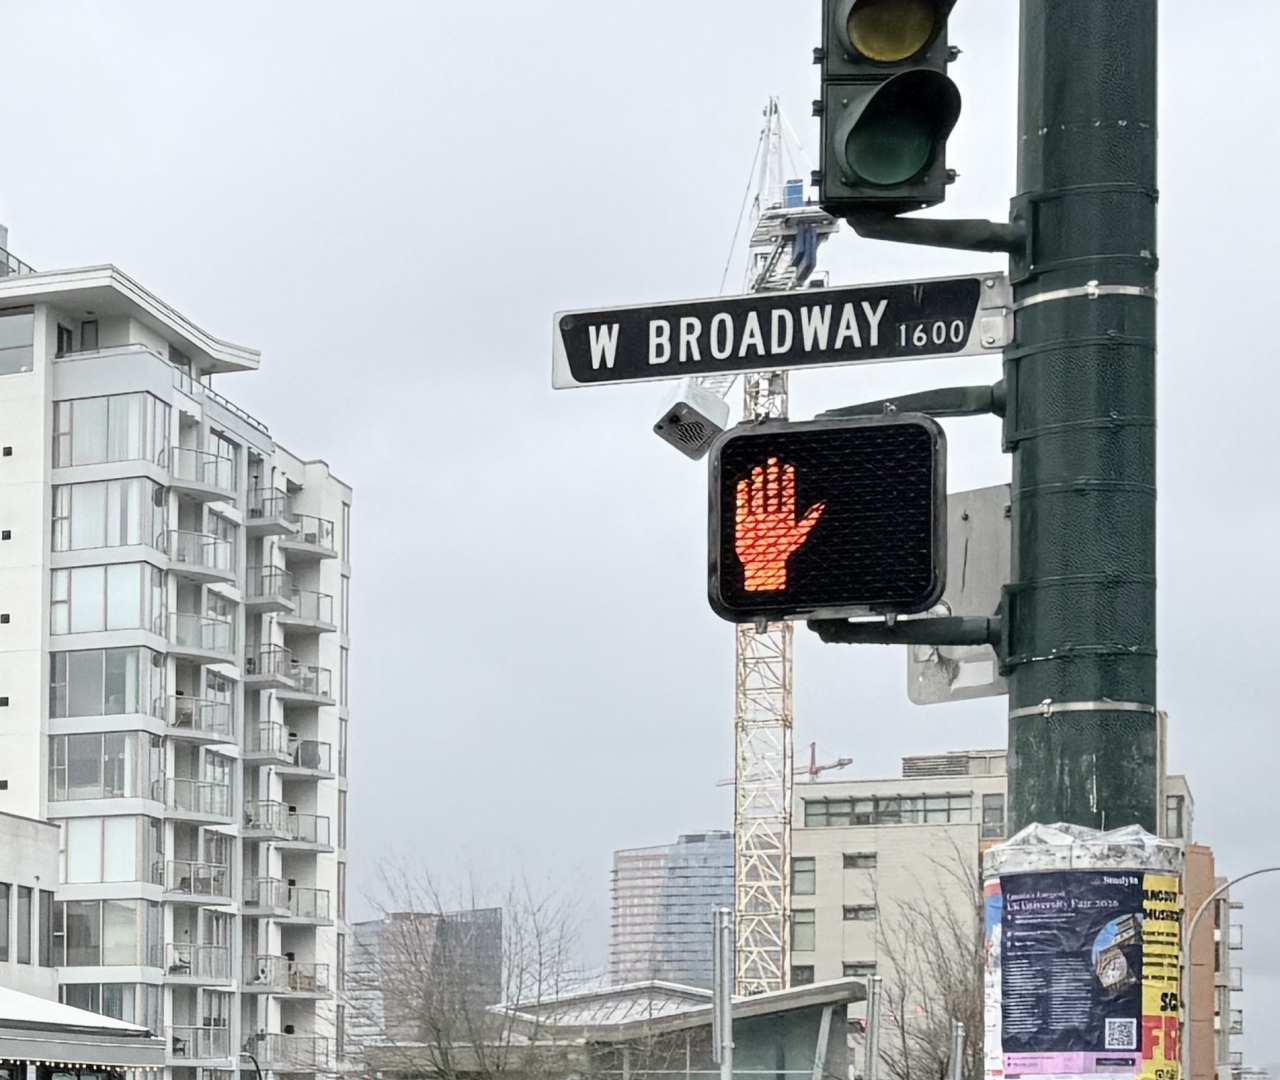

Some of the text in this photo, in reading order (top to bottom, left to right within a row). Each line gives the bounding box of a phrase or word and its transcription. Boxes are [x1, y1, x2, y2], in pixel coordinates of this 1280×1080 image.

[588, 299, 964, 370] W BROADWAY 1600
